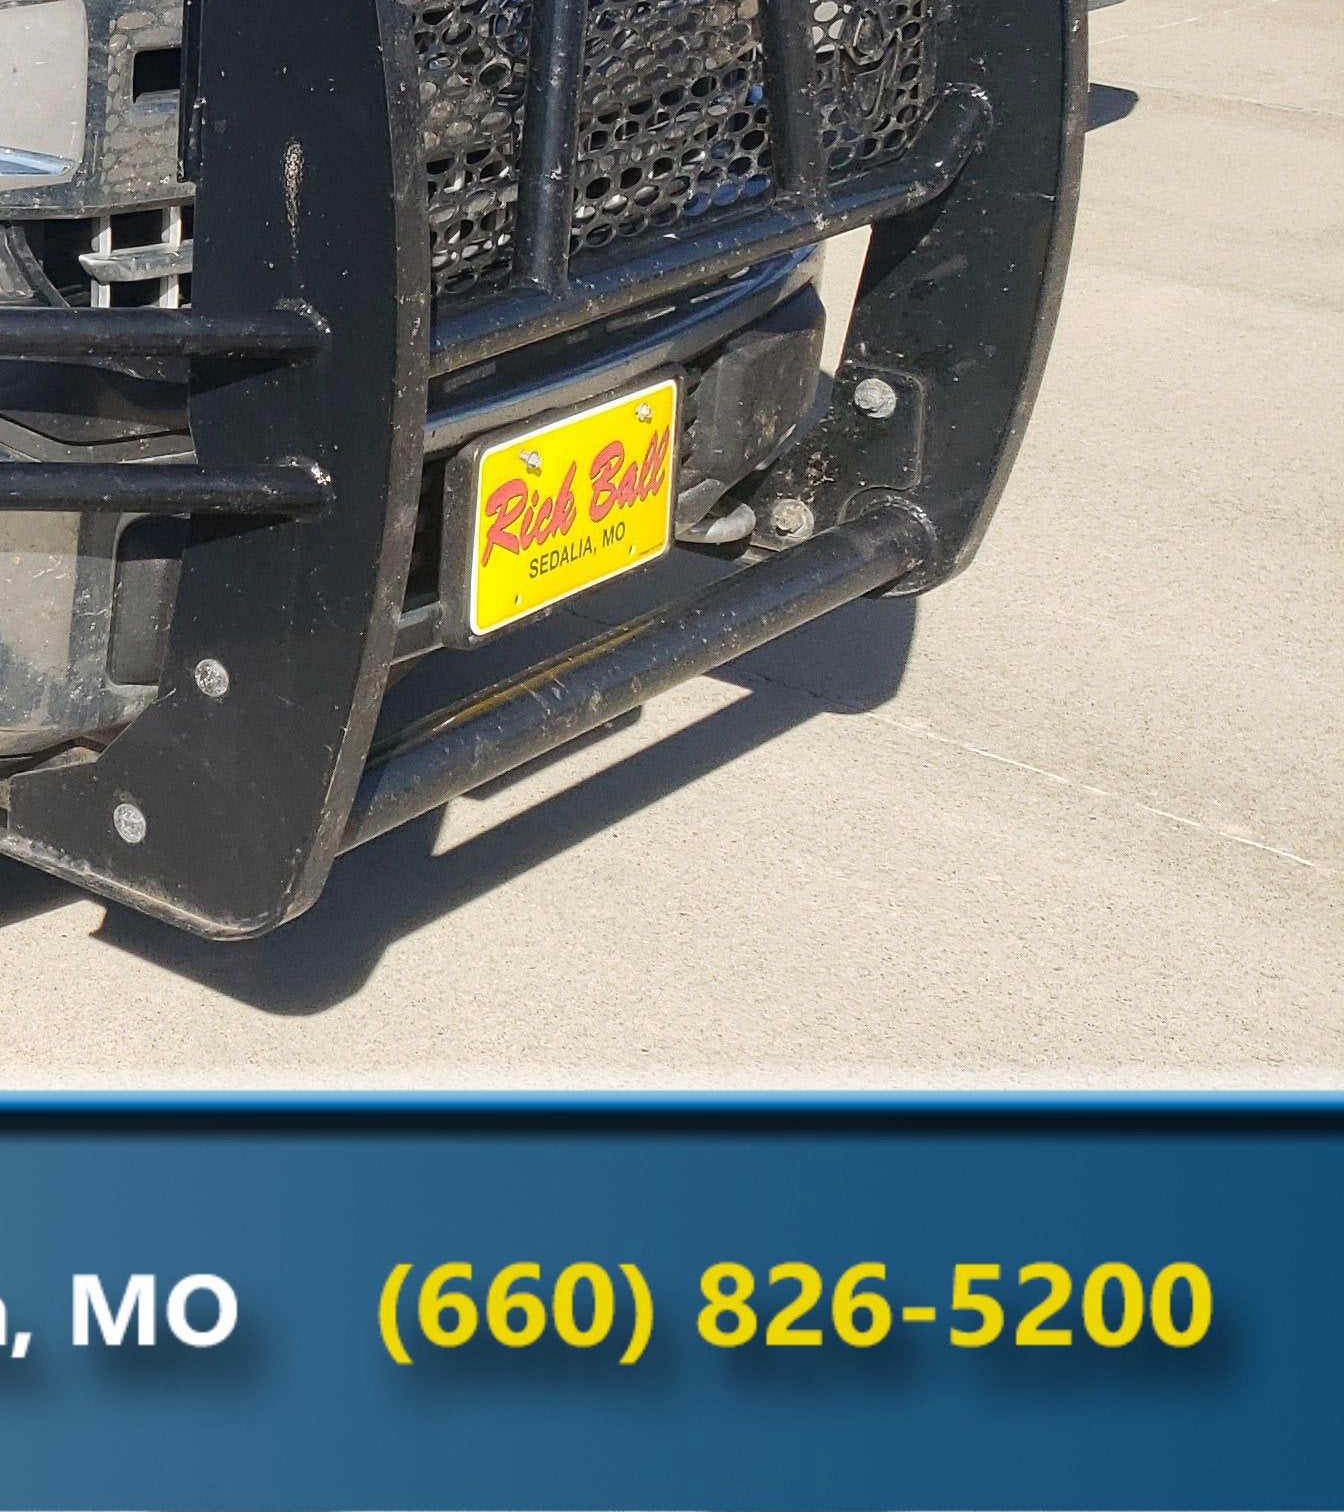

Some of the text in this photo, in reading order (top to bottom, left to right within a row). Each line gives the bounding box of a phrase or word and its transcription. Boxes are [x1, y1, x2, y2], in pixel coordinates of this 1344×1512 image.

[482, 425, 670, 567] Rick Ball
[529, 535, 597, 579] SEDALIA,
[602, 521, 626, 547] MO
